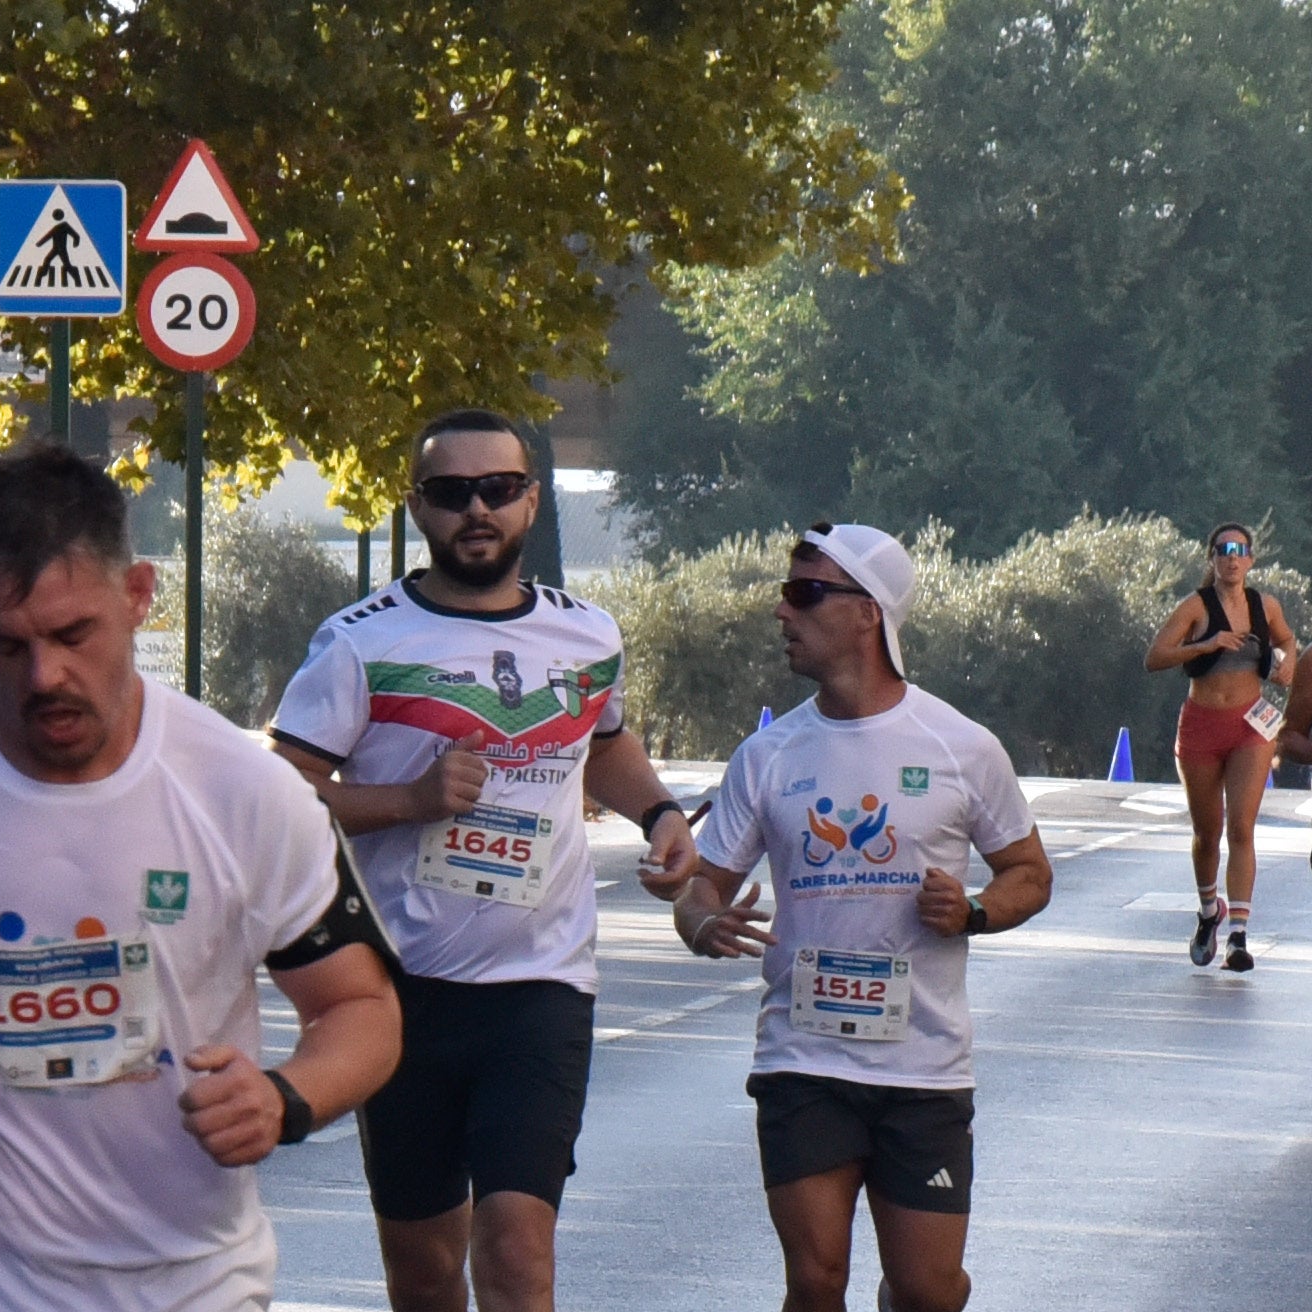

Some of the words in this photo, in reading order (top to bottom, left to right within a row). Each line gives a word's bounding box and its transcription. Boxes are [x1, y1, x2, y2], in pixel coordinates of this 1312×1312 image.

[165, 293, 228, 331] 20
[427, 670, 477, 684] capelli
[505, 767, 569, 785] PALESTIN
[444, 827, 533, 862] 1645
[813, 976, 886, 1002] 1512
